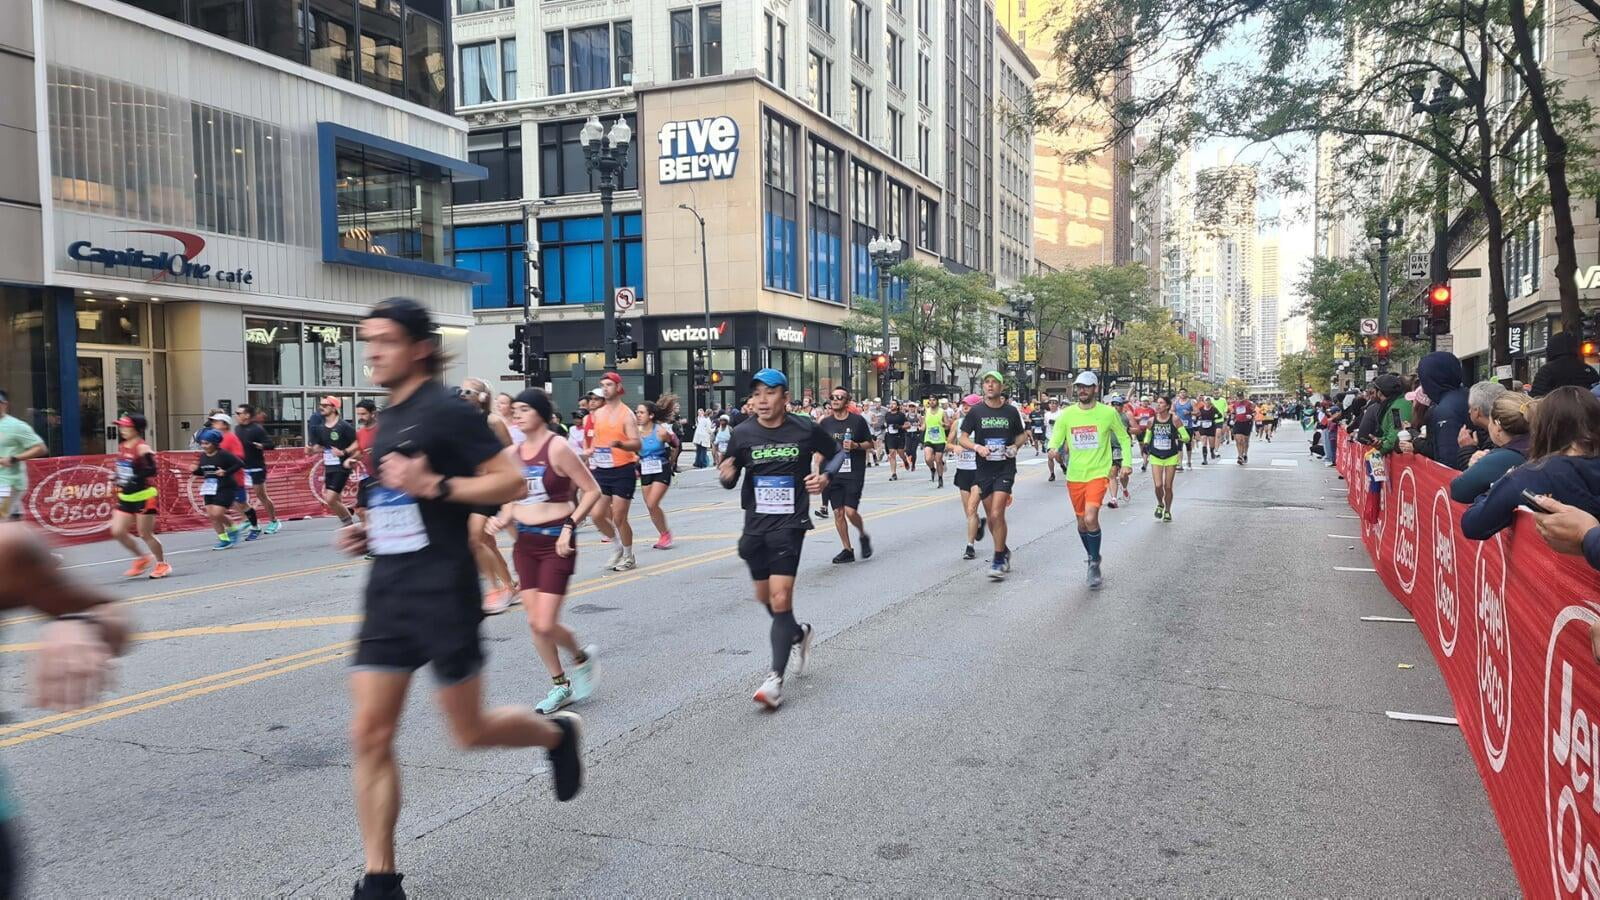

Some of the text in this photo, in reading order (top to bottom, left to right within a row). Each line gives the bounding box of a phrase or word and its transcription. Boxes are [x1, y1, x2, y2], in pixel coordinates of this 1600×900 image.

[658, 116, 738, 156] five
[659, 151, 738, 184] BELOW
[1411, 255, 1429, 263] ONE
[1411, 262, 1429, 270] WAY
[215, 268, 253, 284] café
[661, 325, 719, 342] verizon
[776, 327, 804, 343] verizon
[1508, 327, 1521, 354] VANS
[751, 446, 799, 460] CHICAGO
[44, 480, 113, 503] Jewel
[49, 502, 112, 524] Osco
[1479, 558, 1503, 655] Jewel
[1481, 630, 1504, 730] Osco
